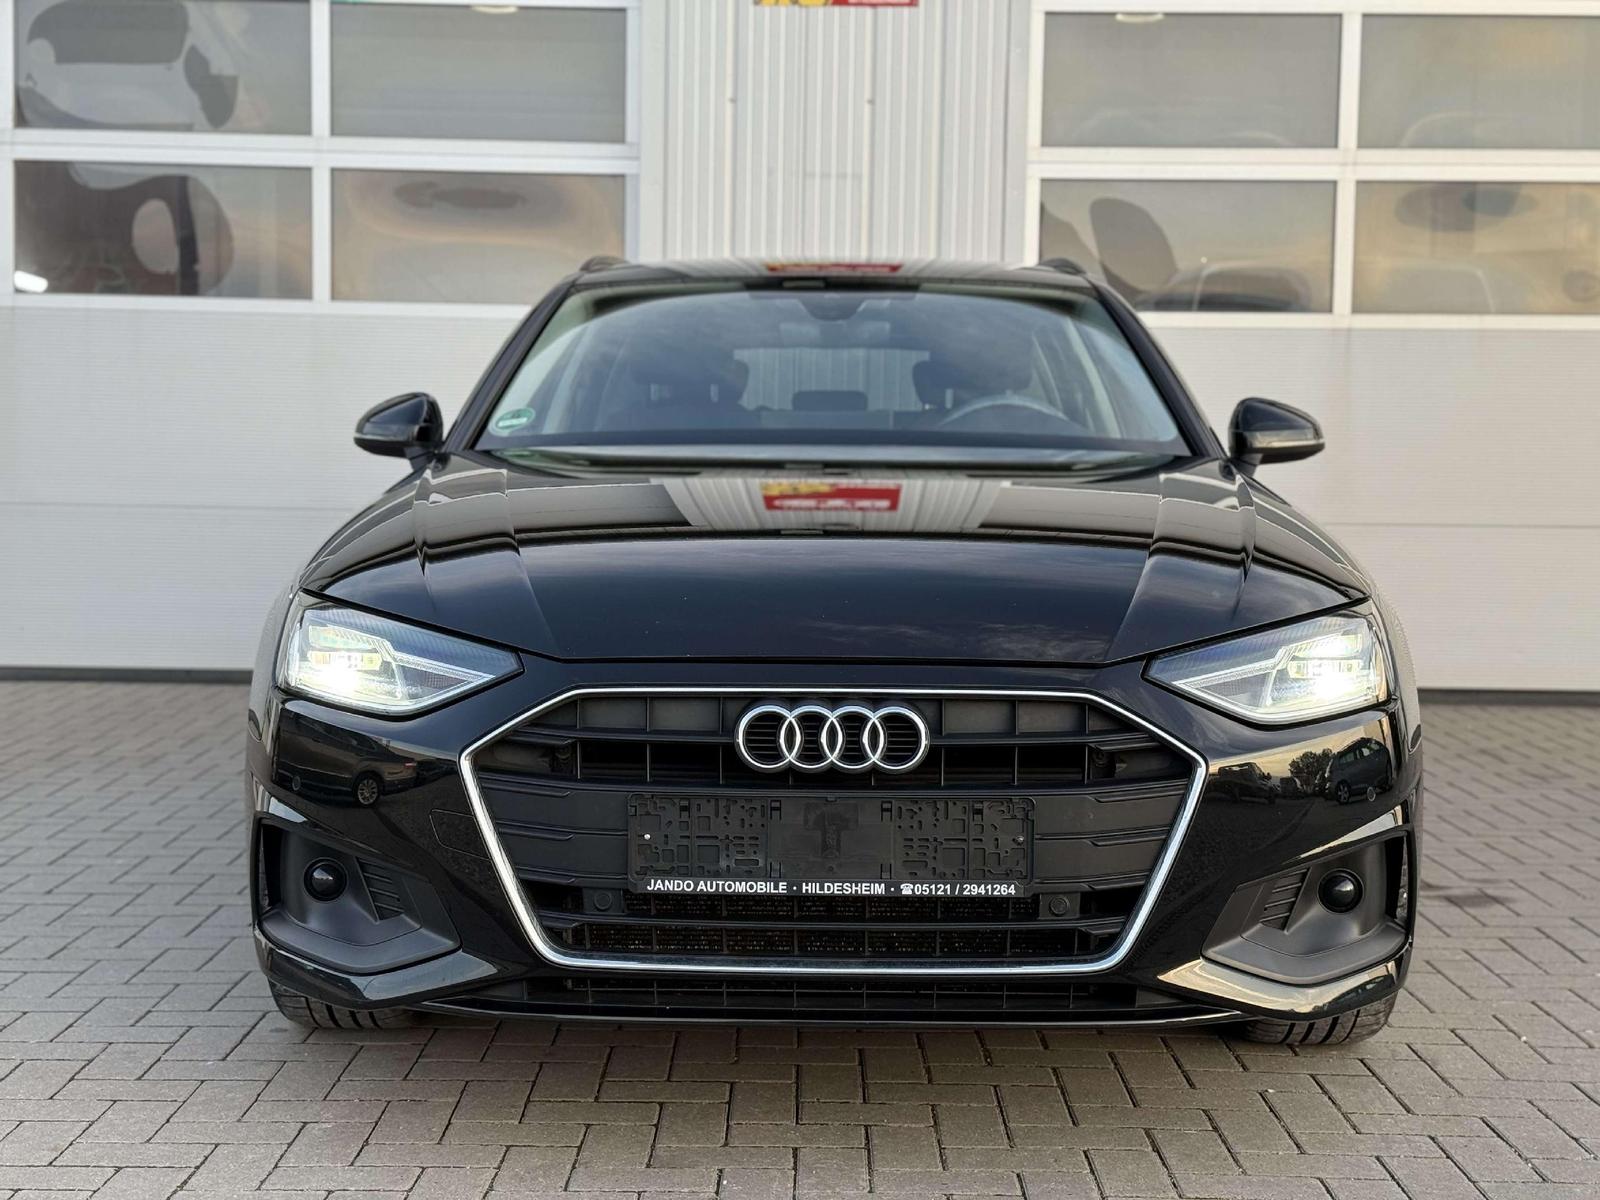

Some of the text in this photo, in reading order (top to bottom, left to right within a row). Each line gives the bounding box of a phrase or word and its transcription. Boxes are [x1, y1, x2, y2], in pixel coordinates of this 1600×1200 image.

[647, 879, 695, 893] JANDO
[696, 879, 788, 894] AUTOMOBILE
[801, 882, 886, 896] HILDESHEIM
[962, 883, 1016, 896] 2941264
